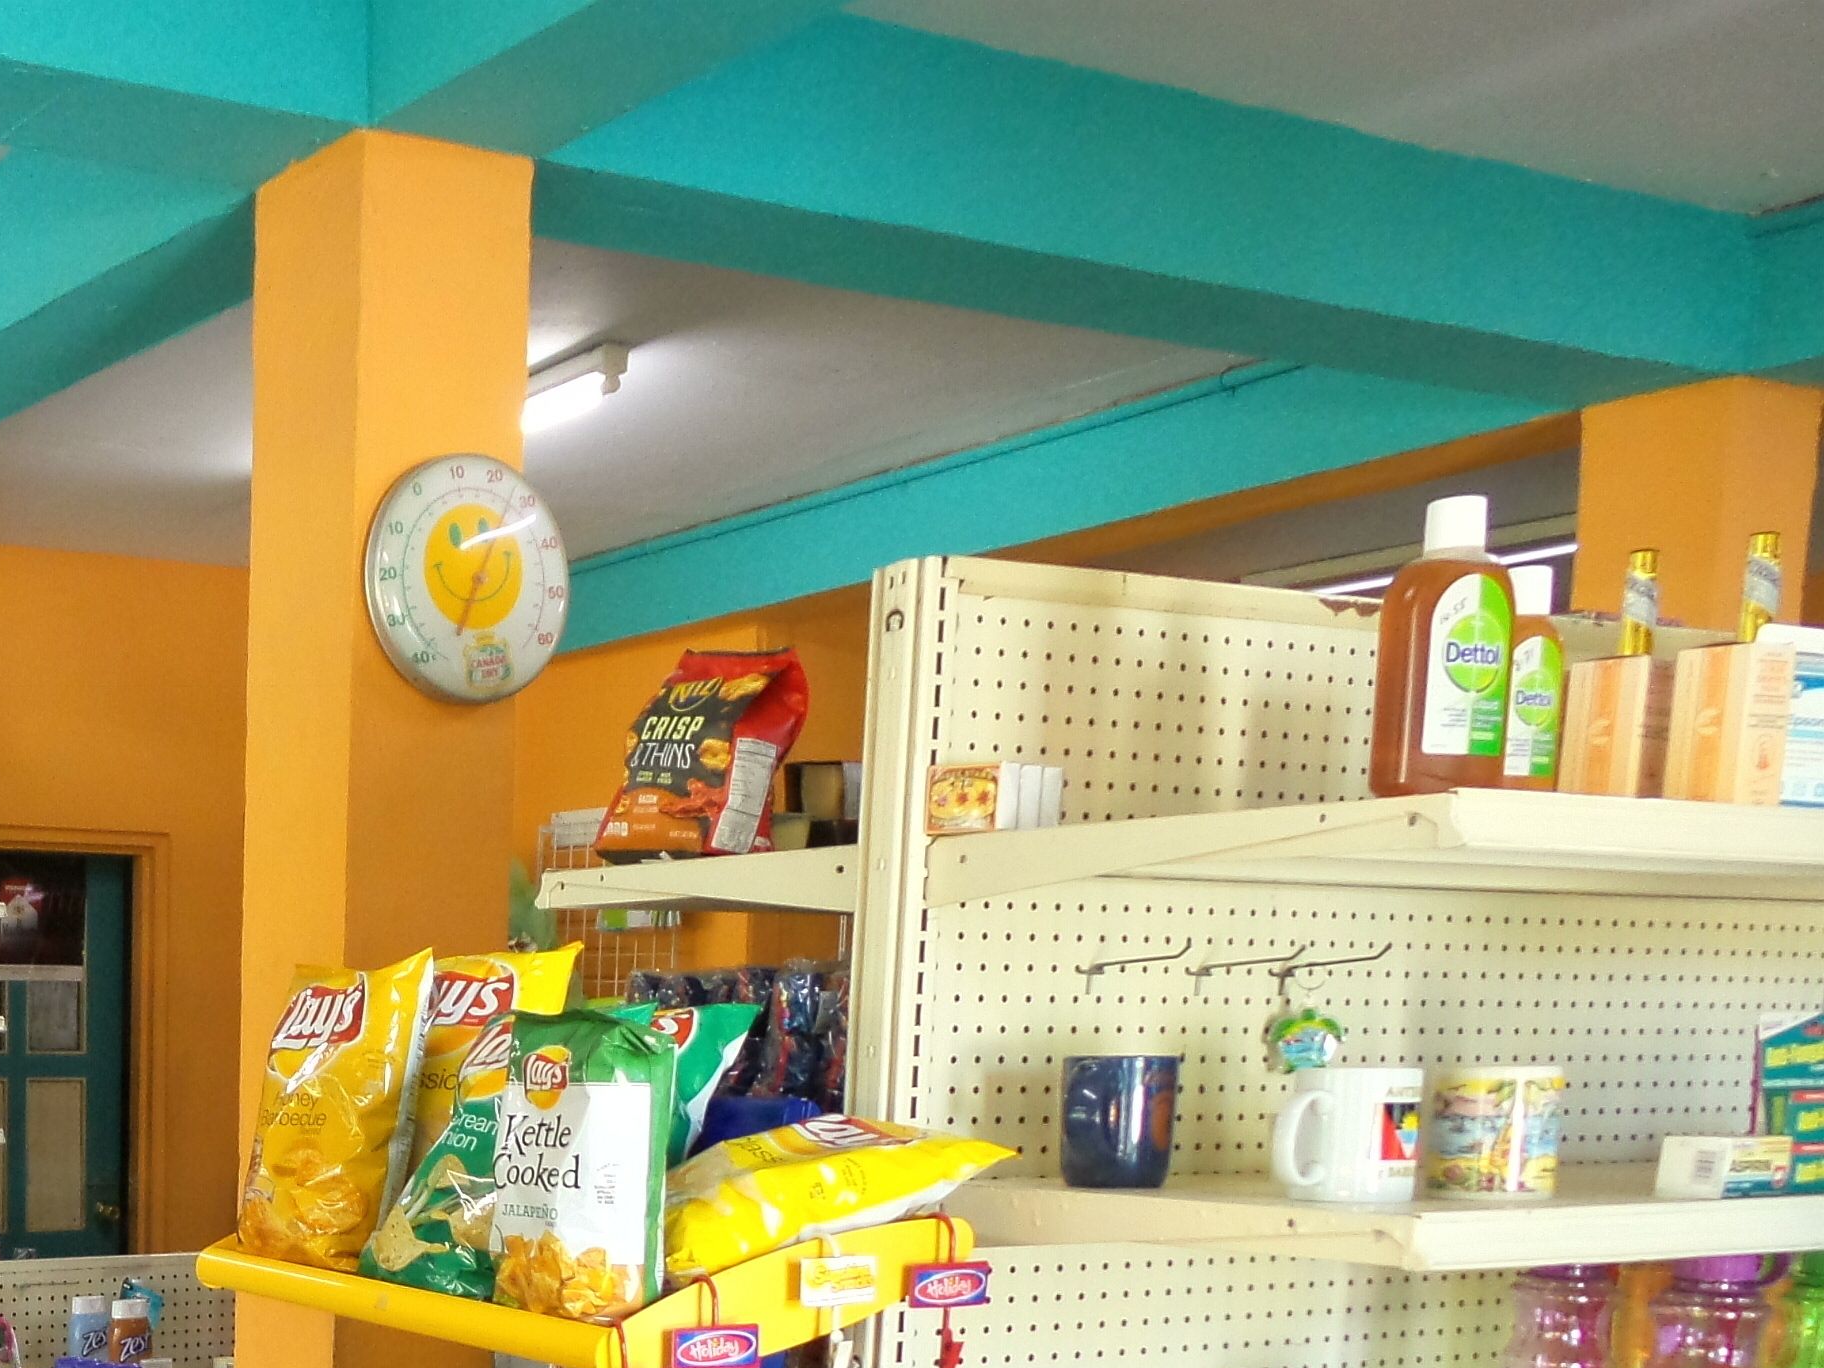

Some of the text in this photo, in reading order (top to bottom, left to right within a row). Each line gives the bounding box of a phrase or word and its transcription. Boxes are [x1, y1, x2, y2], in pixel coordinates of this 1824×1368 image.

[449, 465, 465, 479] 10
[487, 469, 503, 483] 20
[413, 482, 423, 496] 0
[389, 522, 404, 536] 10
[540, 537, 558, 550] 40
[379, 567, 397, 582] 20
[548, 587, 564, 600] 50
[537, 633, 554, 645] 60
[471, 656, 507, 668] CANADA
[1445, 641, 1500, 665] Dettol
[1515, 689, 1553, 707] Dettol
[641, 715, 705, 740] CRISP
[642, 742, 695, 769] THINS
[432, 979, 511, 1026] y's
[271, 986, 363, 1049] Lay's
[526, 1054, 563, 1091] Lay's
[442, 1130, 477, 1152] nion
[501, 1114, 572, 1156] Kettle
[492, 1153, 582, 1190] Cooked
[502, 1202, 559, 1221] JALAPEÑO
[925, 1272, 973, 1297] Holiday
[81, 1329, 108, 1356] Zes
[690, 1334, 740, 1360] Holiday
